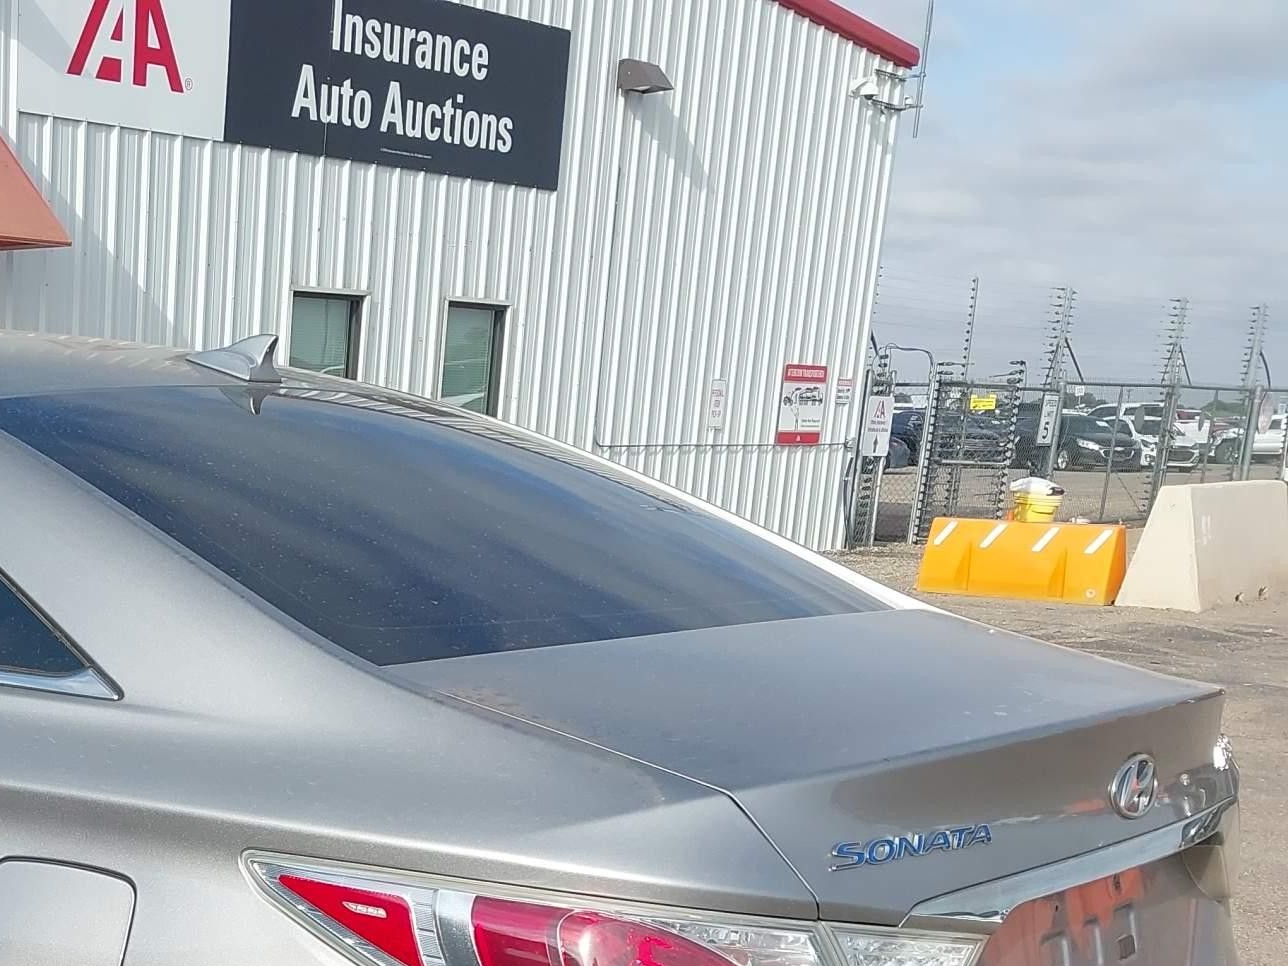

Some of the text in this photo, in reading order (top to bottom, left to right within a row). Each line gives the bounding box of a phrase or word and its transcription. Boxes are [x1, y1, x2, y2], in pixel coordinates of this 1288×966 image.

[331, 0, 490, 81] Insurance
[290, 63, 514, 153] Auto Auctions
[1041, 420, 1050, 440] 5
[828, 823, 993, 872] SONATA
